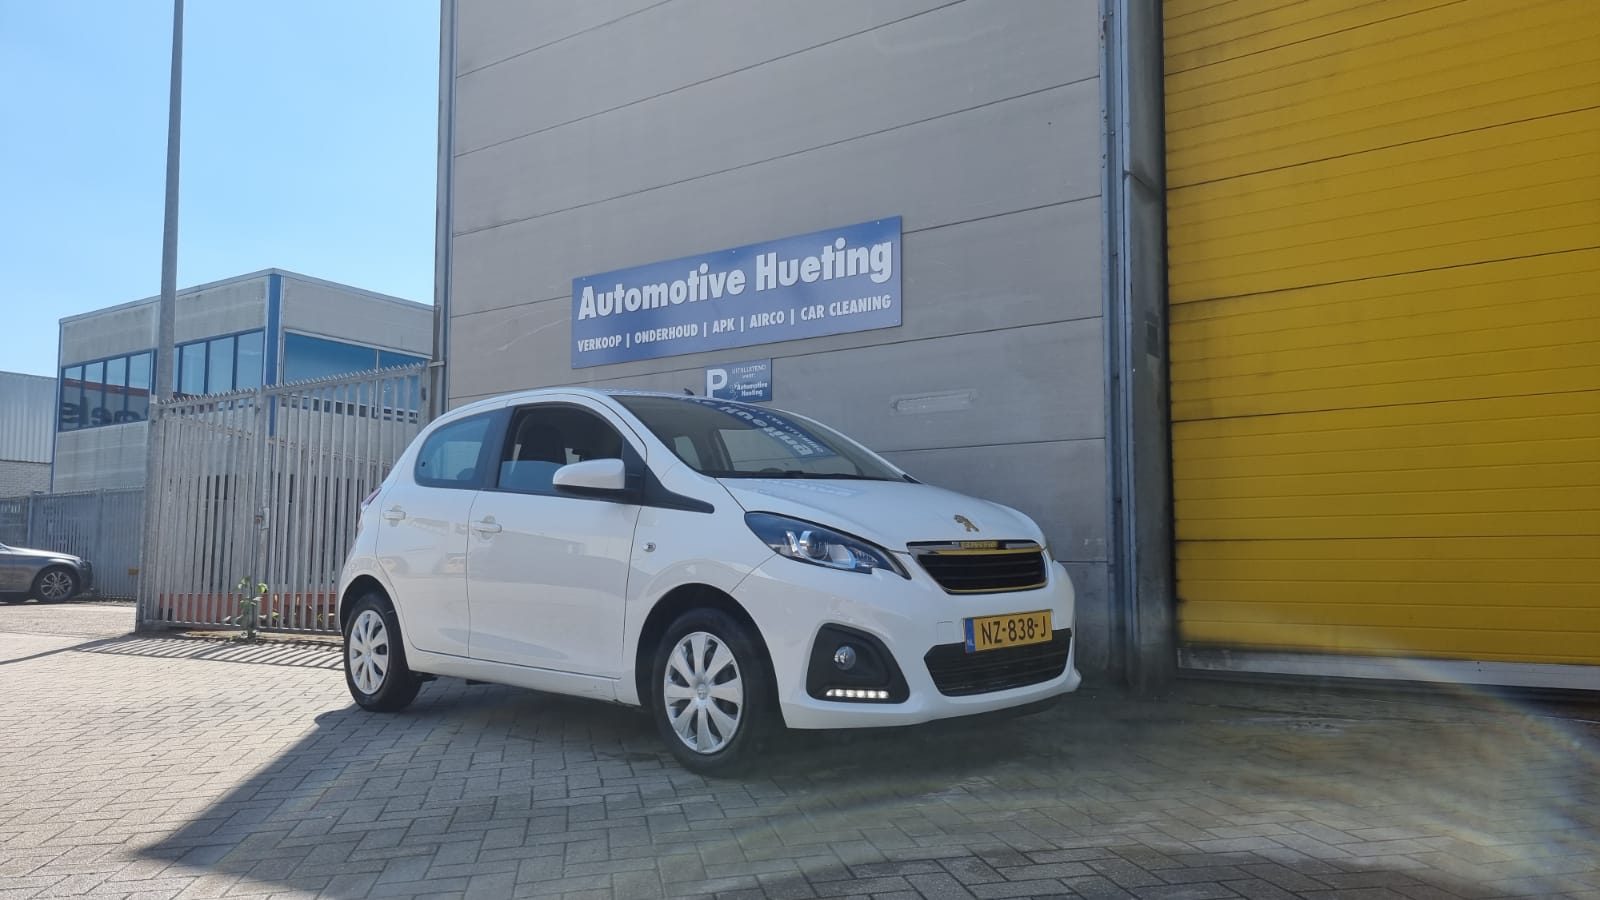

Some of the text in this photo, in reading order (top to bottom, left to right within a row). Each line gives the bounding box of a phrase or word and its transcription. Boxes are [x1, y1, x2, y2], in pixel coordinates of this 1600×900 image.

[578, 237, 892, 320] Automotive Hueting
[577, 294, 892, 352] VERKOOP ONDERHOUD APK AIRCO CAR CLEANING
[706, 368, 728, 398] P
[736, 381, 768, 390] Automotive
[981, 615, 1046, 645] NZ-838-J
